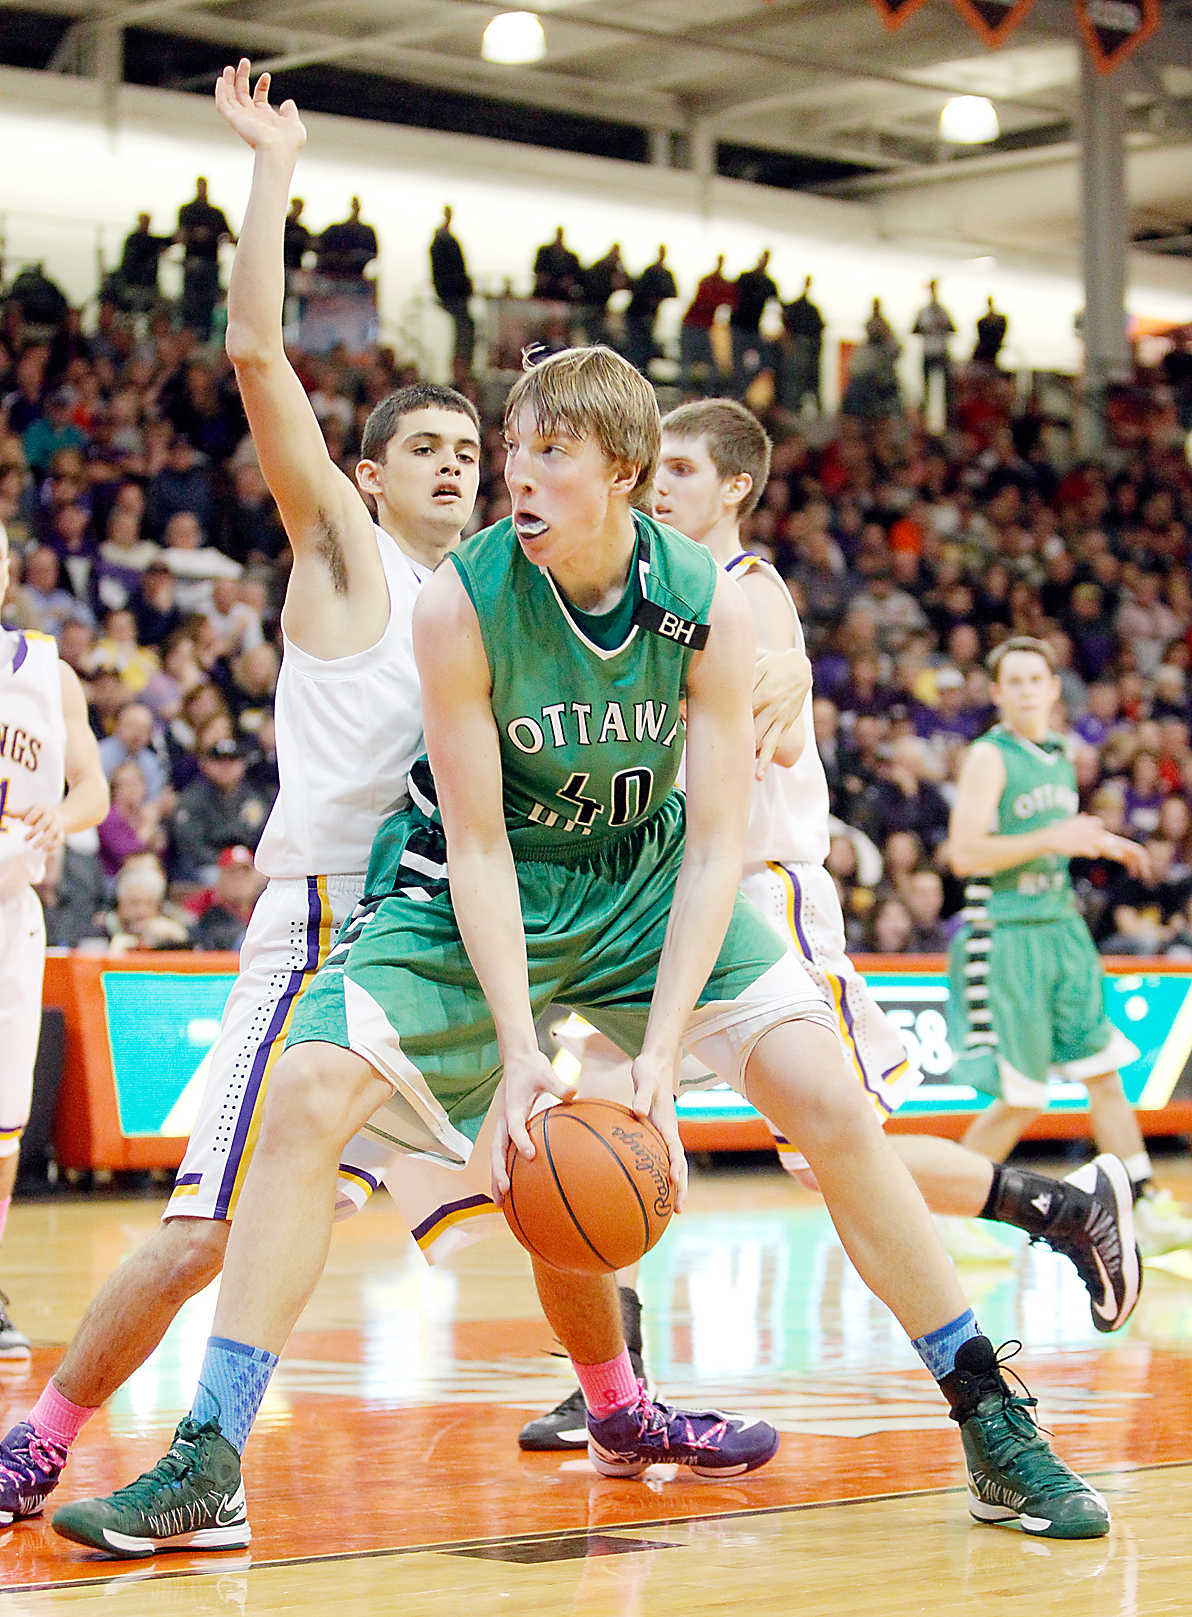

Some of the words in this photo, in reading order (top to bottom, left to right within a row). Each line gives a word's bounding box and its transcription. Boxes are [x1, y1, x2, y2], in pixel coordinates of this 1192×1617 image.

[658, 611, 696, 644] BH
[556, 766, 654, 827] 40
[612, 1126, 671, 1217] Rawlings
